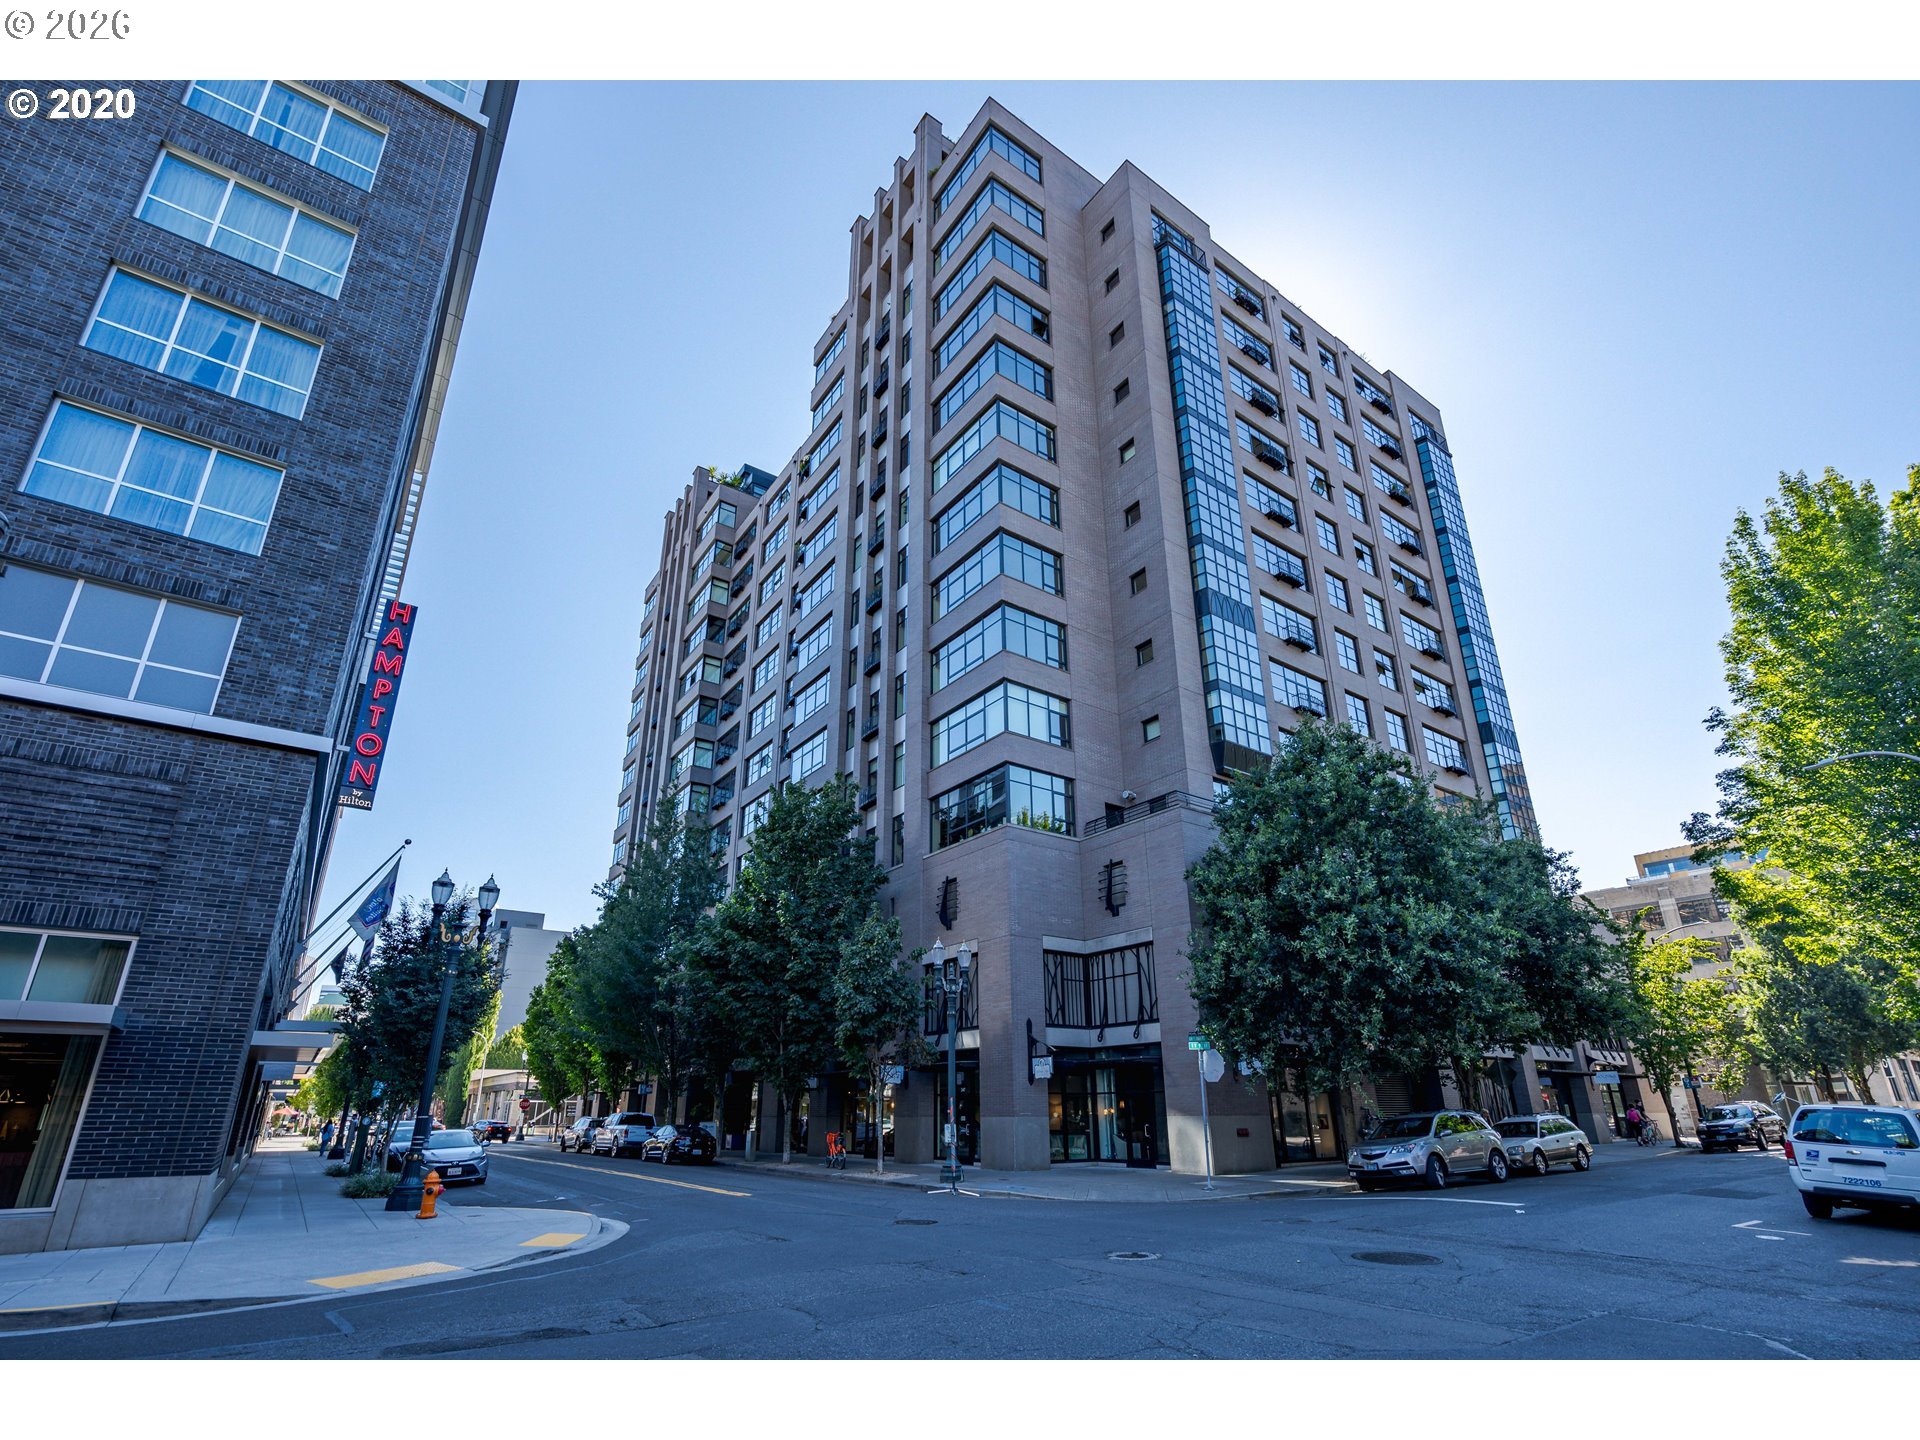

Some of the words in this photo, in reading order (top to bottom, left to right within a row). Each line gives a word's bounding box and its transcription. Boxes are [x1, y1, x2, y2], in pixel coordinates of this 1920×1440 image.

[349, 601, 411, 786] HAMPTON
[352, 789, 363, 797] by
[338, 796, 371, 807] Hilton
[1842, 1176, 1882, 1188] 7222106
